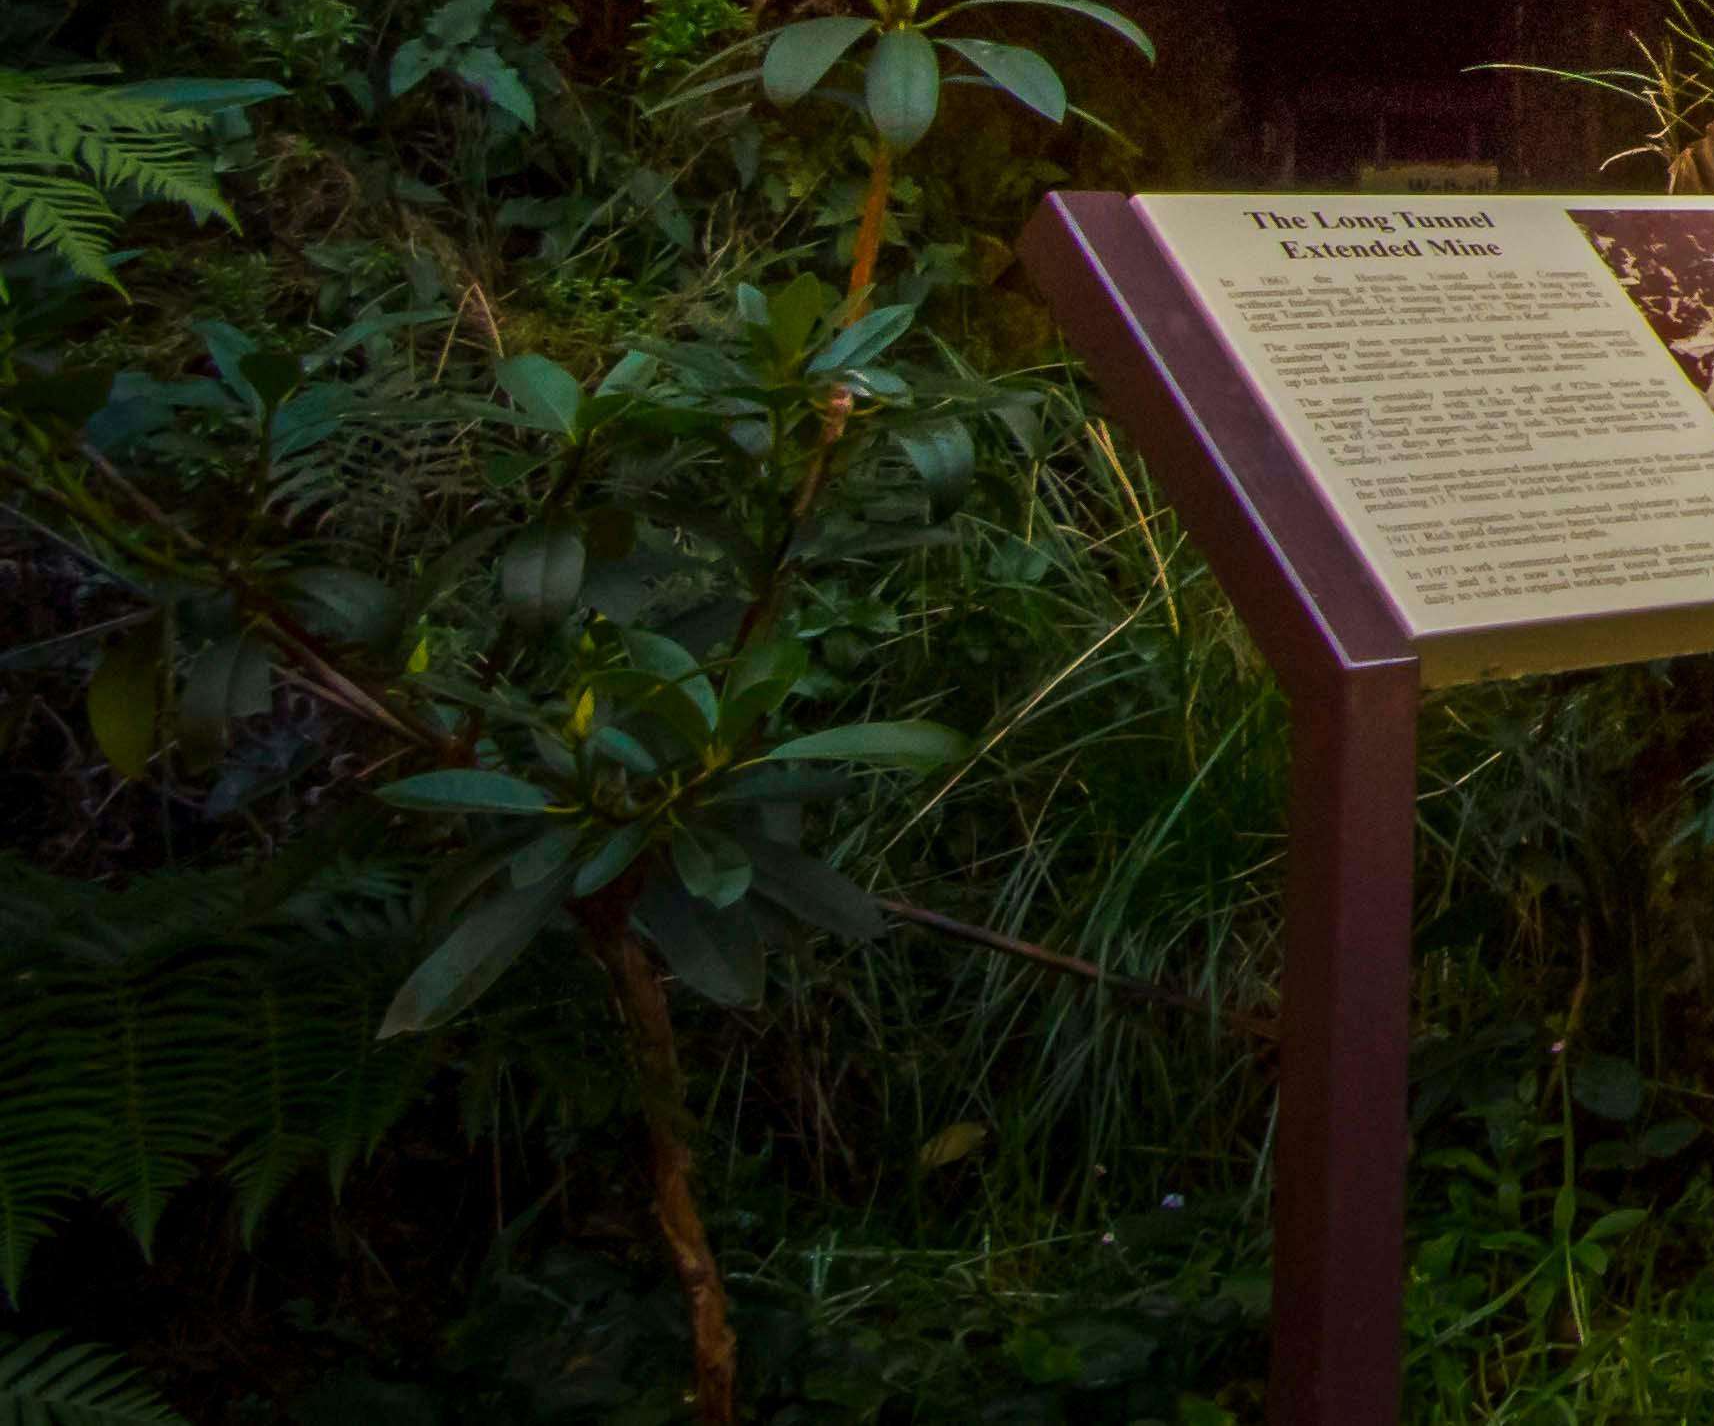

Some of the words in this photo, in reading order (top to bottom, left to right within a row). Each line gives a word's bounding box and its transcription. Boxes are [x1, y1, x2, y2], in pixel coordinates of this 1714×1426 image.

[1243, 211, 1308, 230] The
[1311, 211, 1397, 234] Long
[1392, 211, 1496, 229] Tunnel
[1280, 239, 1424, 260] Extended
[1426, 238, 1504, 257] Mine
